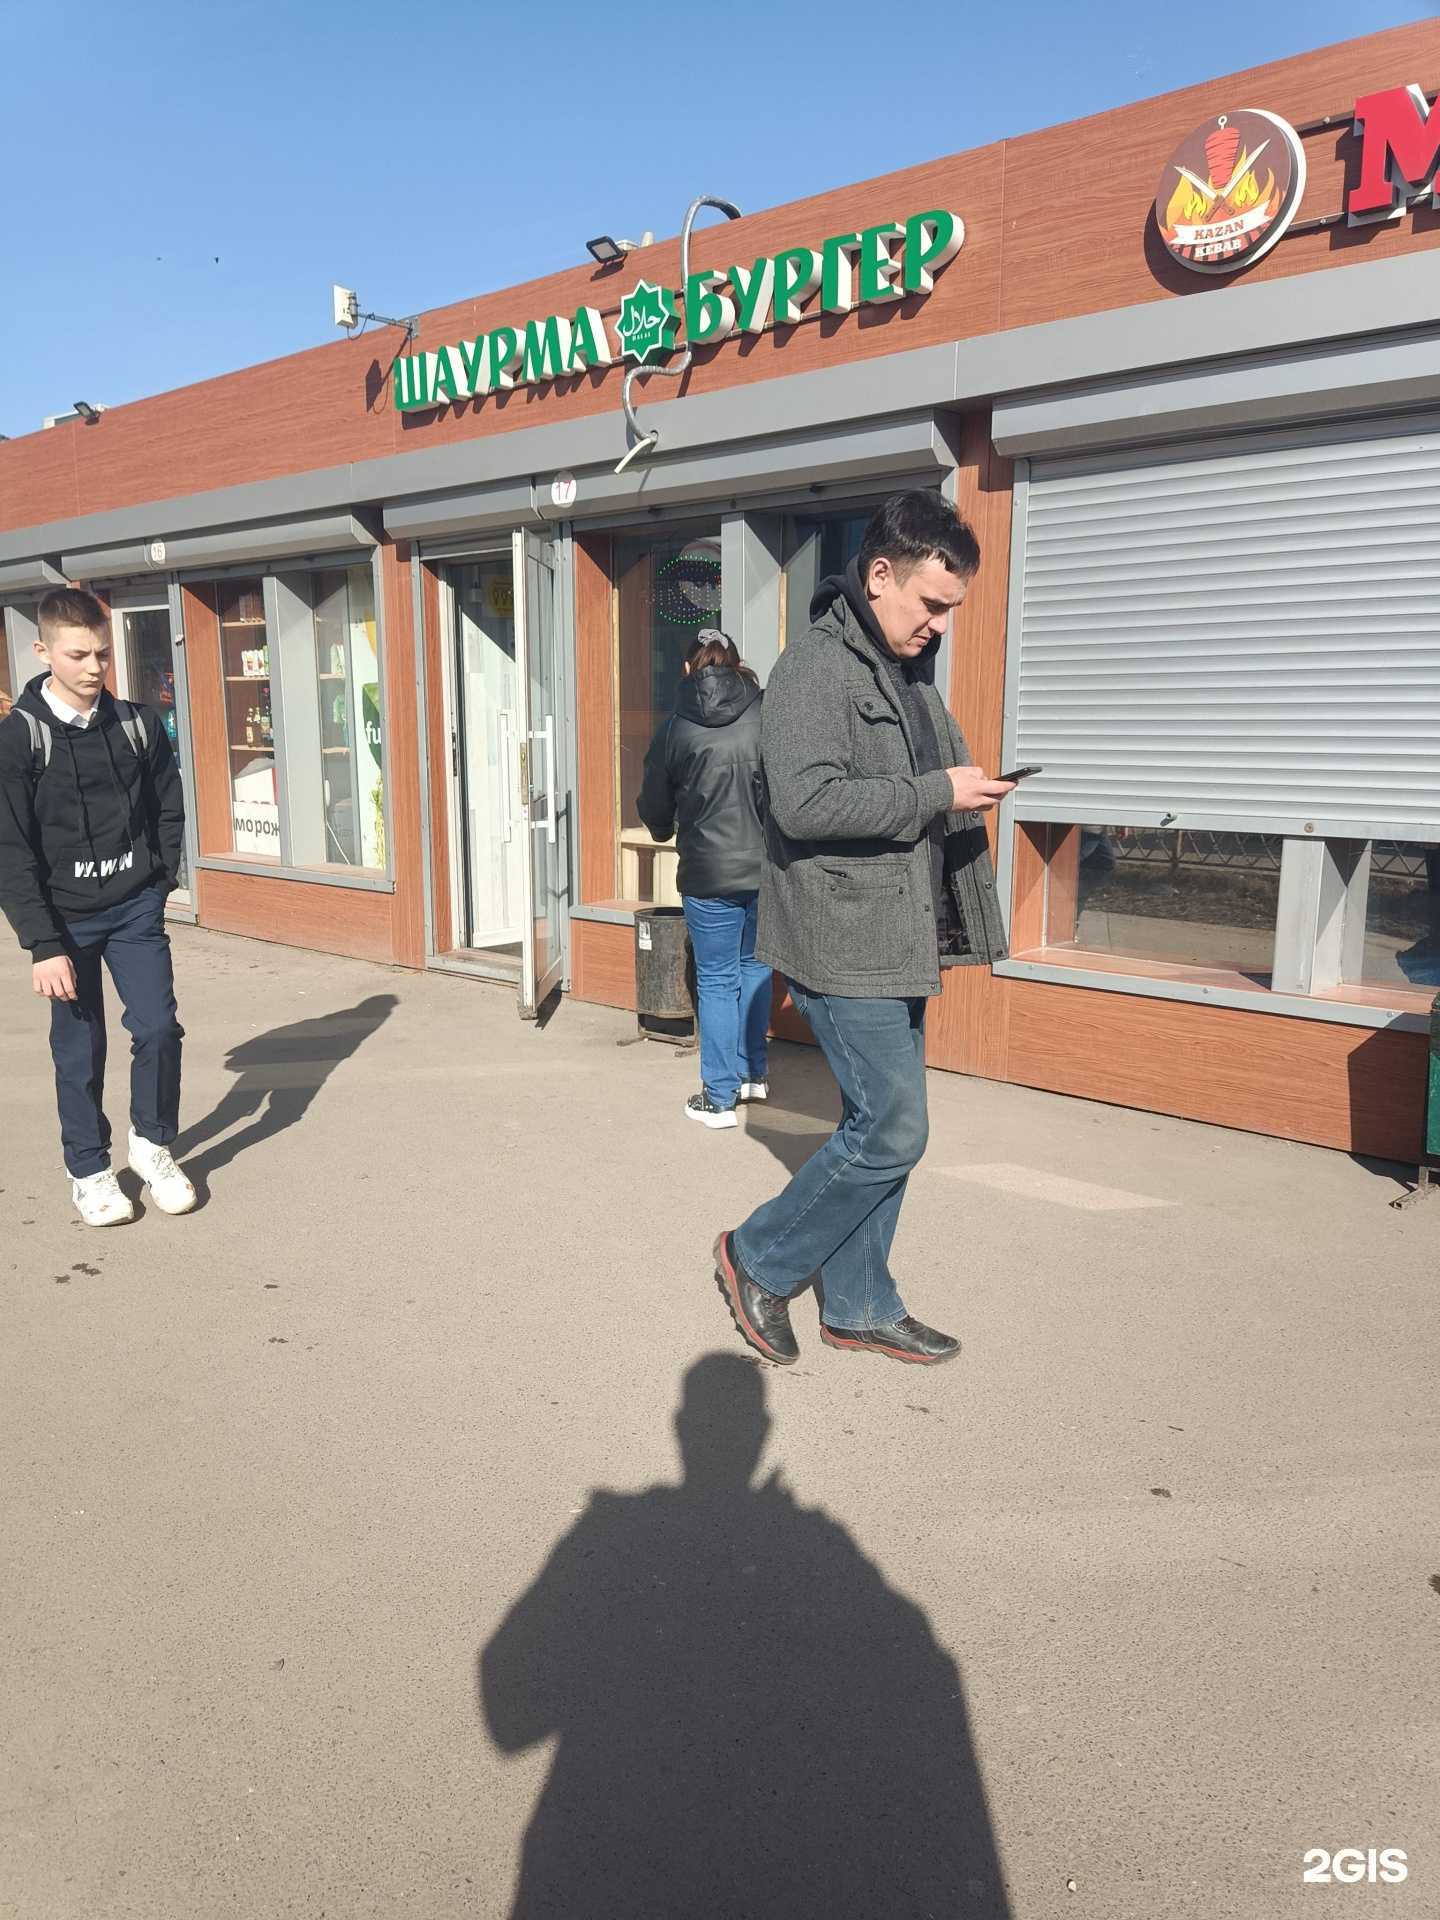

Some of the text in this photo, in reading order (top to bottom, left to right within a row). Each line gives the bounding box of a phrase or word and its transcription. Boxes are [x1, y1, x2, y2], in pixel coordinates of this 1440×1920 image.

[1194, 219, 1244, 240] KAZAN
[1194, 239, 1242, 258] KEBAB
[393, 209, 963, 412] ШАУРМА БУРГЕР
[623, 305, 661, 336] حلال
[555, 479, 572, 501] 17
